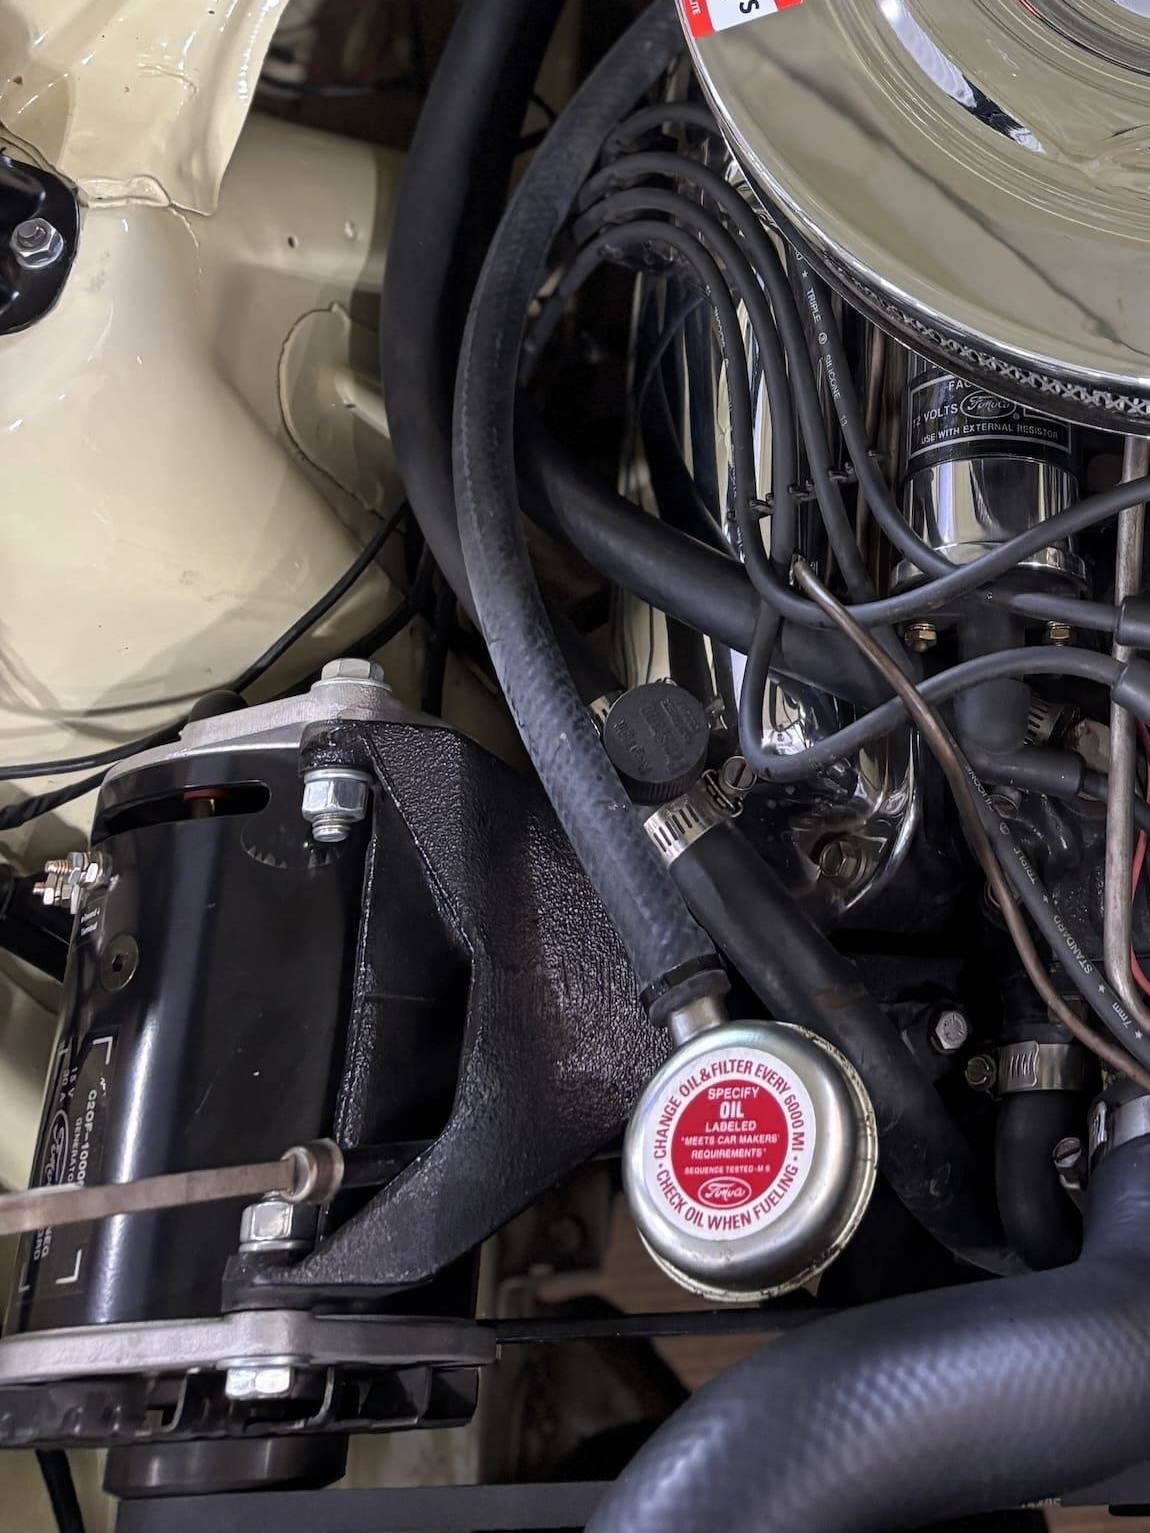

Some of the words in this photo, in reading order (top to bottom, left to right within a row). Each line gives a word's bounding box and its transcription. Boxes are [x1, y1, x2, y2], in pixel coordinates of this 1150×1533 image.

[806, 287, 822, 323] TRIPLE
[823, 353, 840, 401] SILICONE
[924, 404, 958, 423] VOLTS
[921, 433, 936, 445] USE
[938, 427, 960, 439] WITH
[963, 422, 1014, 433] EXTERNAL
[1017, 425, 1057, 440] RESISTOR
[1053, 915, 1093, 974] STANDARD
[1112, 1002, 1131, 1028] 7mm
[755, 1064, 791, 1095] EVERY
[708, 1086, 759, 1100] SPECIFY
[720, 1101, 744, 1119] OIL
[784, 1094, 804, 1129] 6000
[654, 1096, 682, 1159] CHANGE
[705, 1120, 757, 1133] LABELED
[67, 1117, 82, 1183] GENERATO
[717, 1135, 736, 1145] CAR
[792, 1131, 805, 1151] MI
[684, 1165, 723, 1175] SEQUENCE
[657, 1169, 686, 1214] CHECK
[685, 1206, 703, 1227] OIL
[708, 1212, 752, 1231] WHEN
[753, 1164, 798, 1221] FUELING
